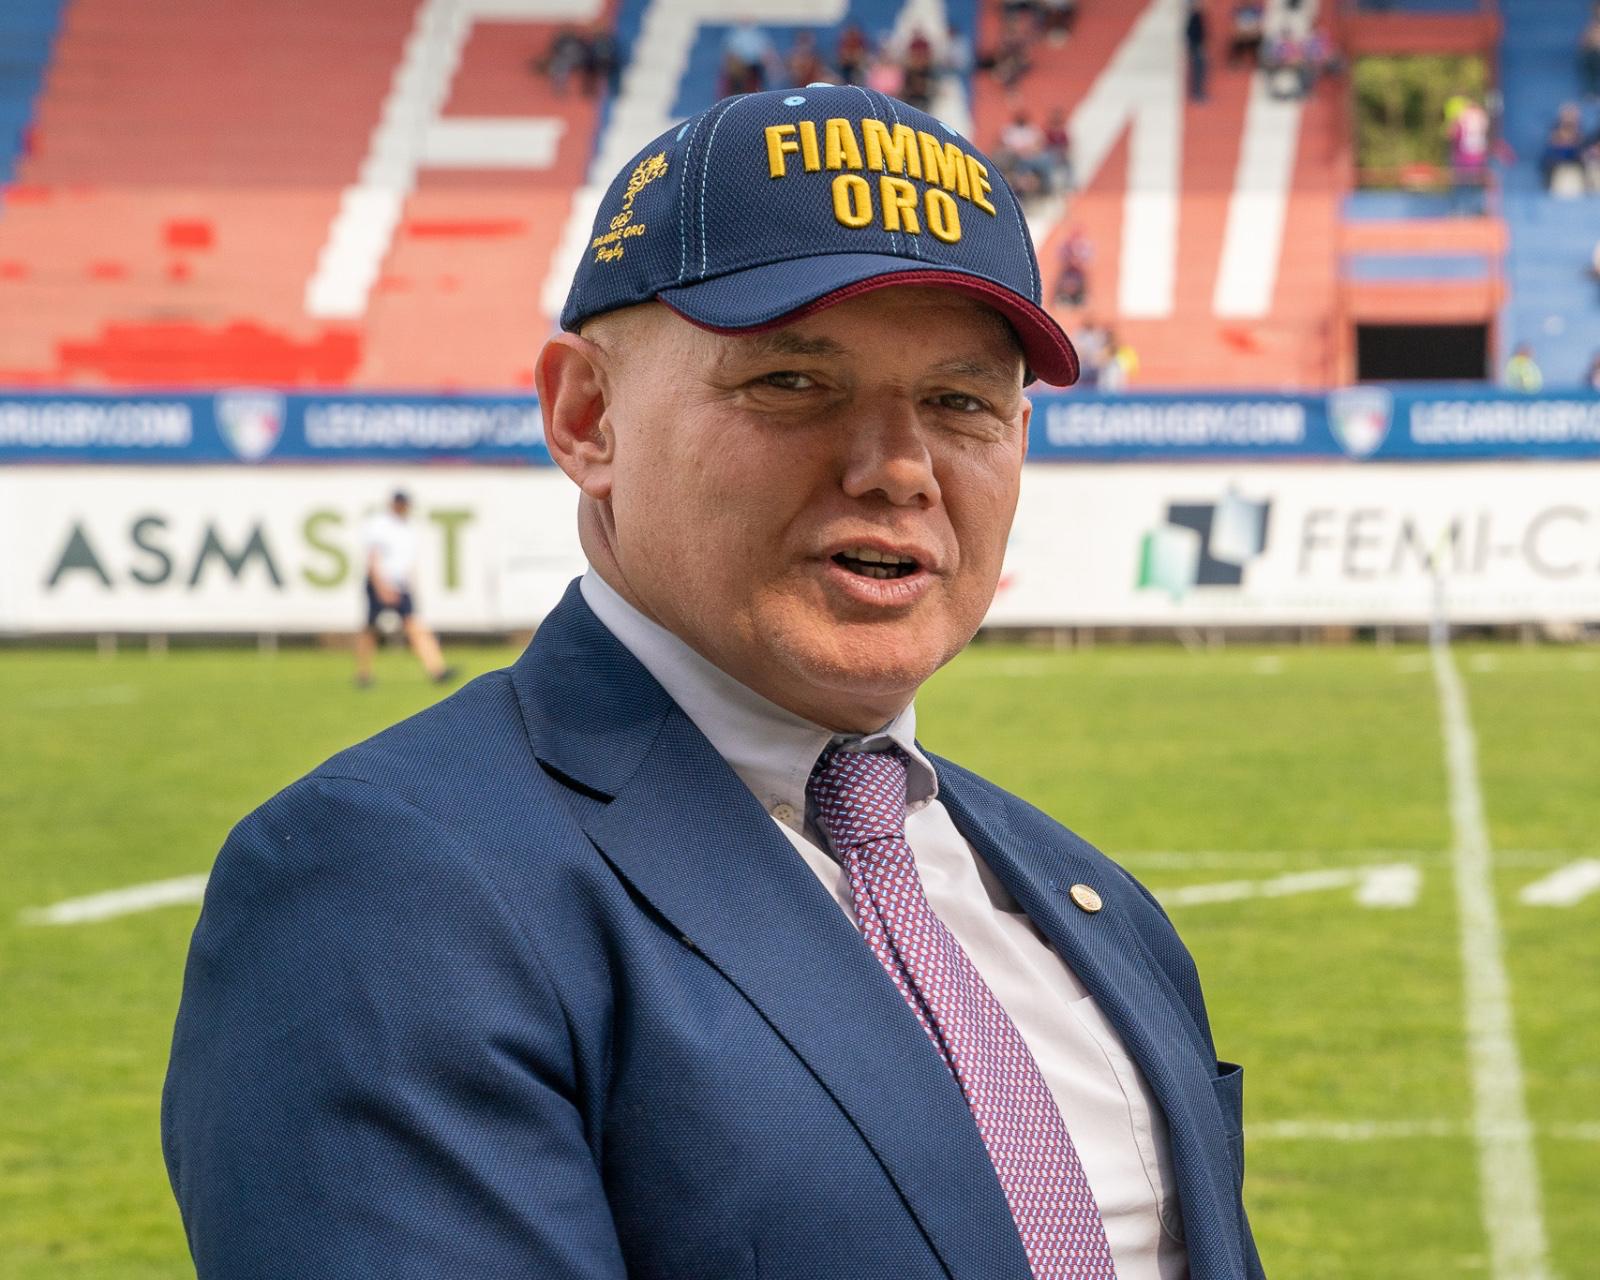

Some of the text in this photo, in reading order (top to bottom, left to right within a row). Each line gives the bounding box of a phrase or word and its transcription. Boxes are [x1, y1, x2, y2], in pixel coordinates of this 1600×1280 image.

[764, 117, 997, 218] FIAMME
[623, 224, 646, 238] ORO
[831, 173, 963, 244] ORO
[1047, 402, 1306, 446] LEGARUGBY.COM
[48, 513, 476, 591] ASMST
[1301, 505, 1600, 581] FEMI-C
